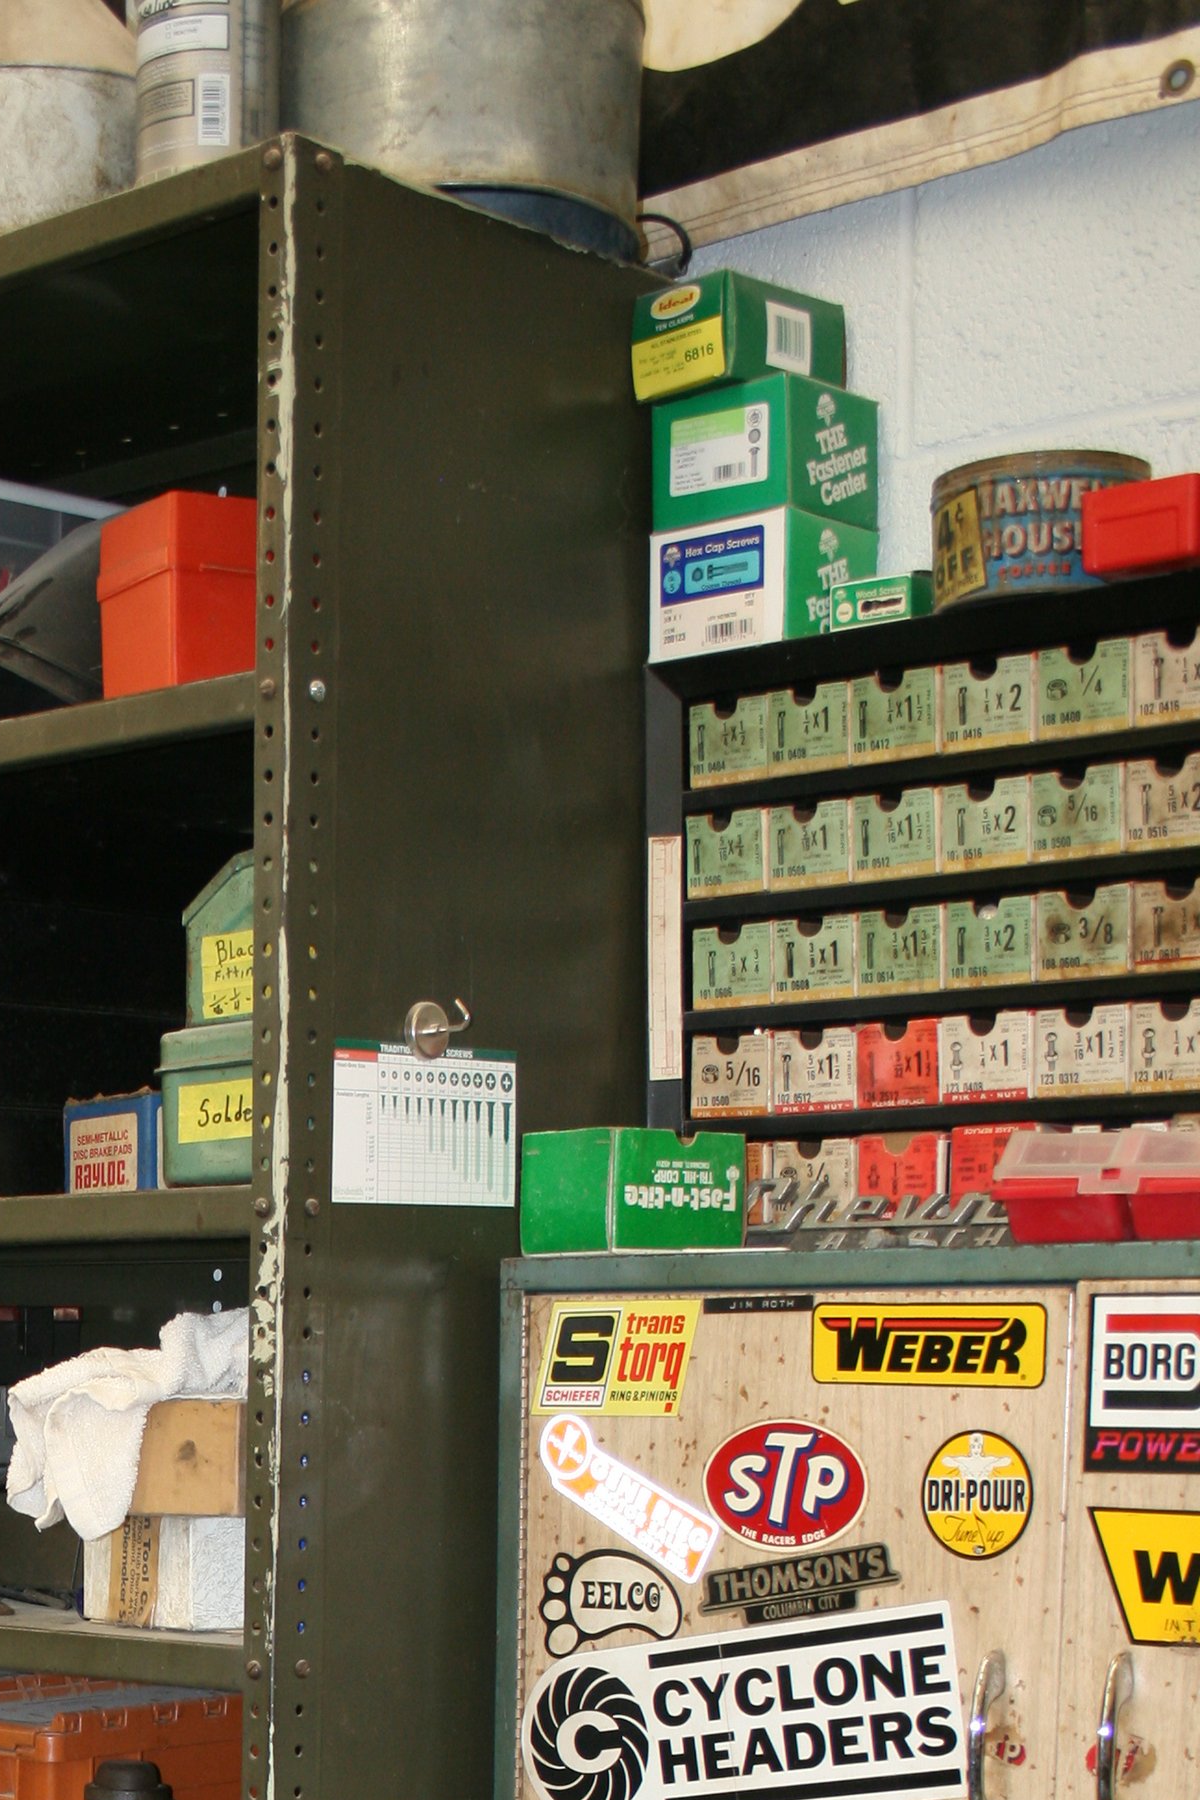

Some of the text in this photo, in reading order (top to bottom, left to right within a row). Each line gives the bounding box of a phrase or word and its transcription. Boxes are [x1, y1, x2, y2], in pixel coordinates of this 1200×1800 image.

[684, 342, 714, 363] 6816
[815, 424, 847, 455] THE
[806, 446, 868, 486] Fastener
[820, 472, 868, 506] Center
[685, 534, 760, 559] Hex Cap Screws
[935, 547, 974, 588] OFF
[998, 561, 1072, 578] COFFEE
[856, 584, 908, 599] Wood Screws
[446, 1048, 473, 1059] SCREWS
[725, 1060, 761, 1088] 5/16
[782, 1102, 844, 1113] PIK A NUT
[952, 1092, 971, 1102] PIK
[996, 1090, 1019, 1099] NUT
[73, 1143, 133, 1160] DISC BRAKE PADS
[76, 1128, 128, 1147] SEMI-METALLIC
[651, 1168, 714, 1185] TRI-HIL CORP.
[623, 1184, 737, 1212] Fast-n-tite
[728, 1298, 795, 1310] JIM ROTH
[627, 1313, 685, 1335] trans
[551, 1316, 615, 1382] S
[820, 1317, 1027, 1375] WEBER
[616, 1337, 687, 1391] torq
[1103, 1342, 1197, 1381] BORG
[545, 1389, 601, 1402] SCHIEFER
[724, 1432, 850, 1532] STP
[927, 1478, 1027, 1514] DRI-POWR
[740, 1524, 827, 1546] THE RACERS EDGE
[943, 1514, 978, 1544] Tune
[141, 1537, 151, 1583] Tool
[713, 1548, 887, 1603] THOMSON'S
[580, 1580, 662, 1612] EELCO
[762, 1592, 841, 1621] COLUMBIA CITY
[651, 1645, 951, 1727] CYCLONE
[657, 1706, 960, 1785] HEADERS
